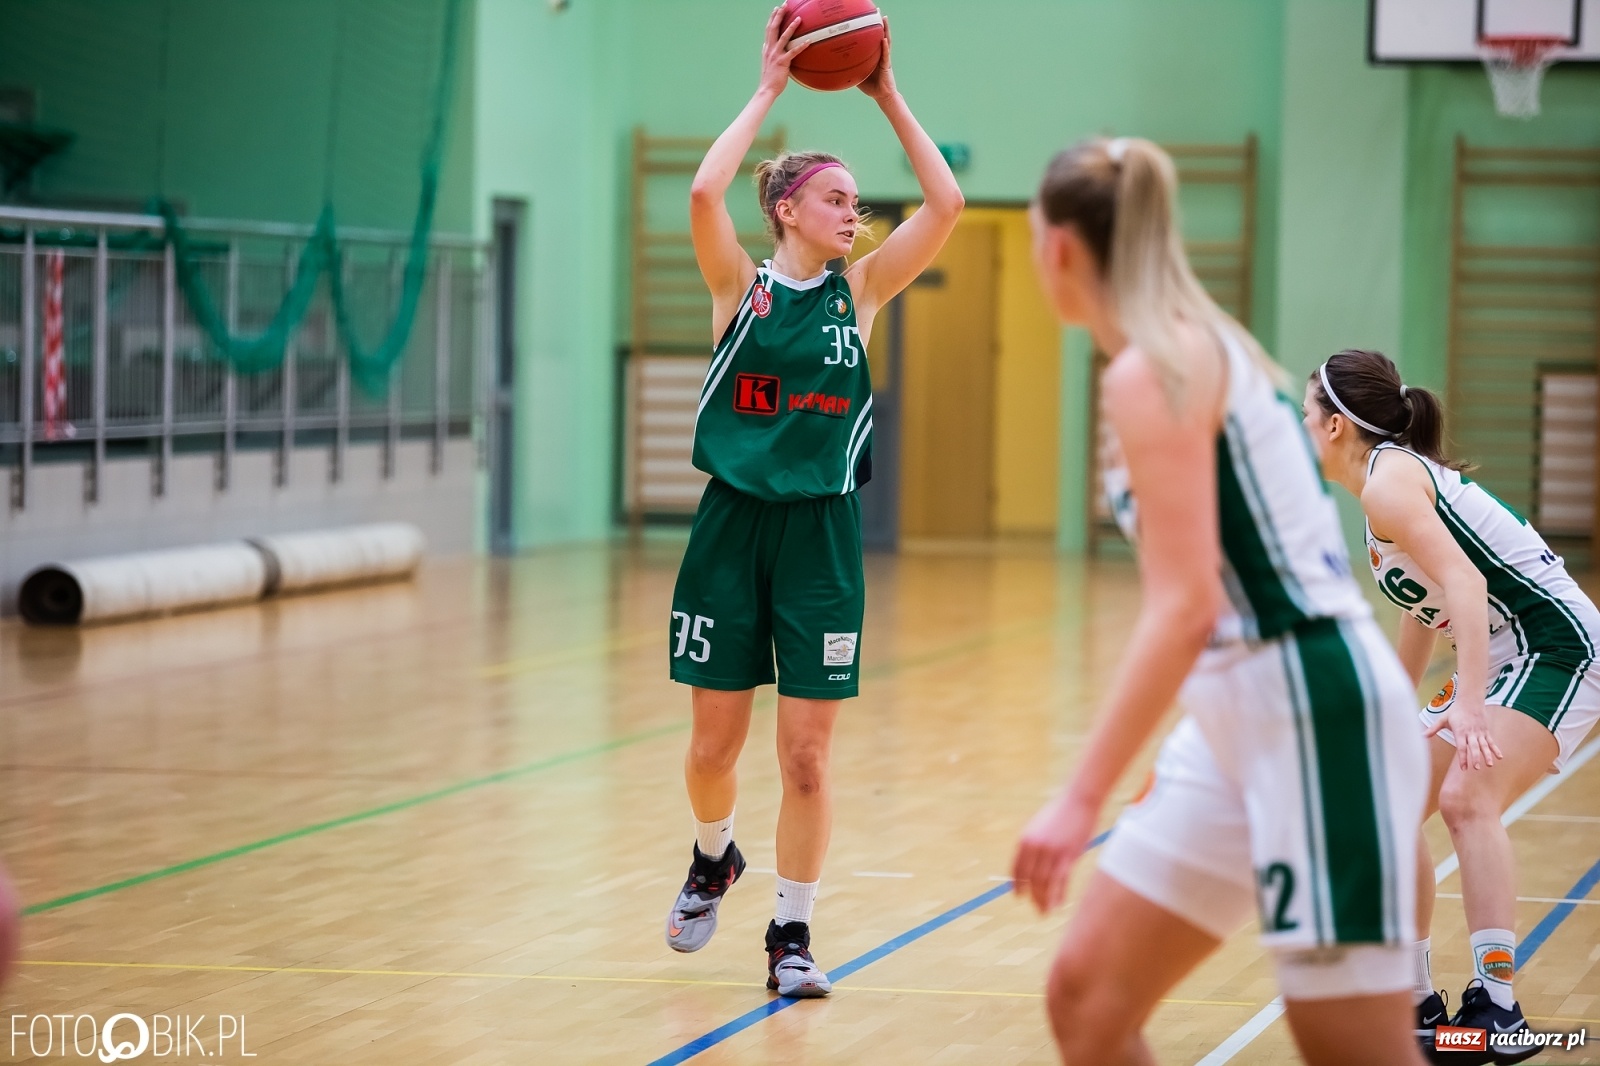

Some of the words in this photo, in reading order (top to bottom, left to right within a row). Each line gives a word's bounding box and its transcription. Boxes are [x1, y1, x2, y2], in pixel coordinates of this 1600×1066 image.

[822, 325, 859, 367] 35
[738, 378, 773, 410] K
[788, 392, 850, 414] KAMAN
[672, 611, 714, 662] 35
